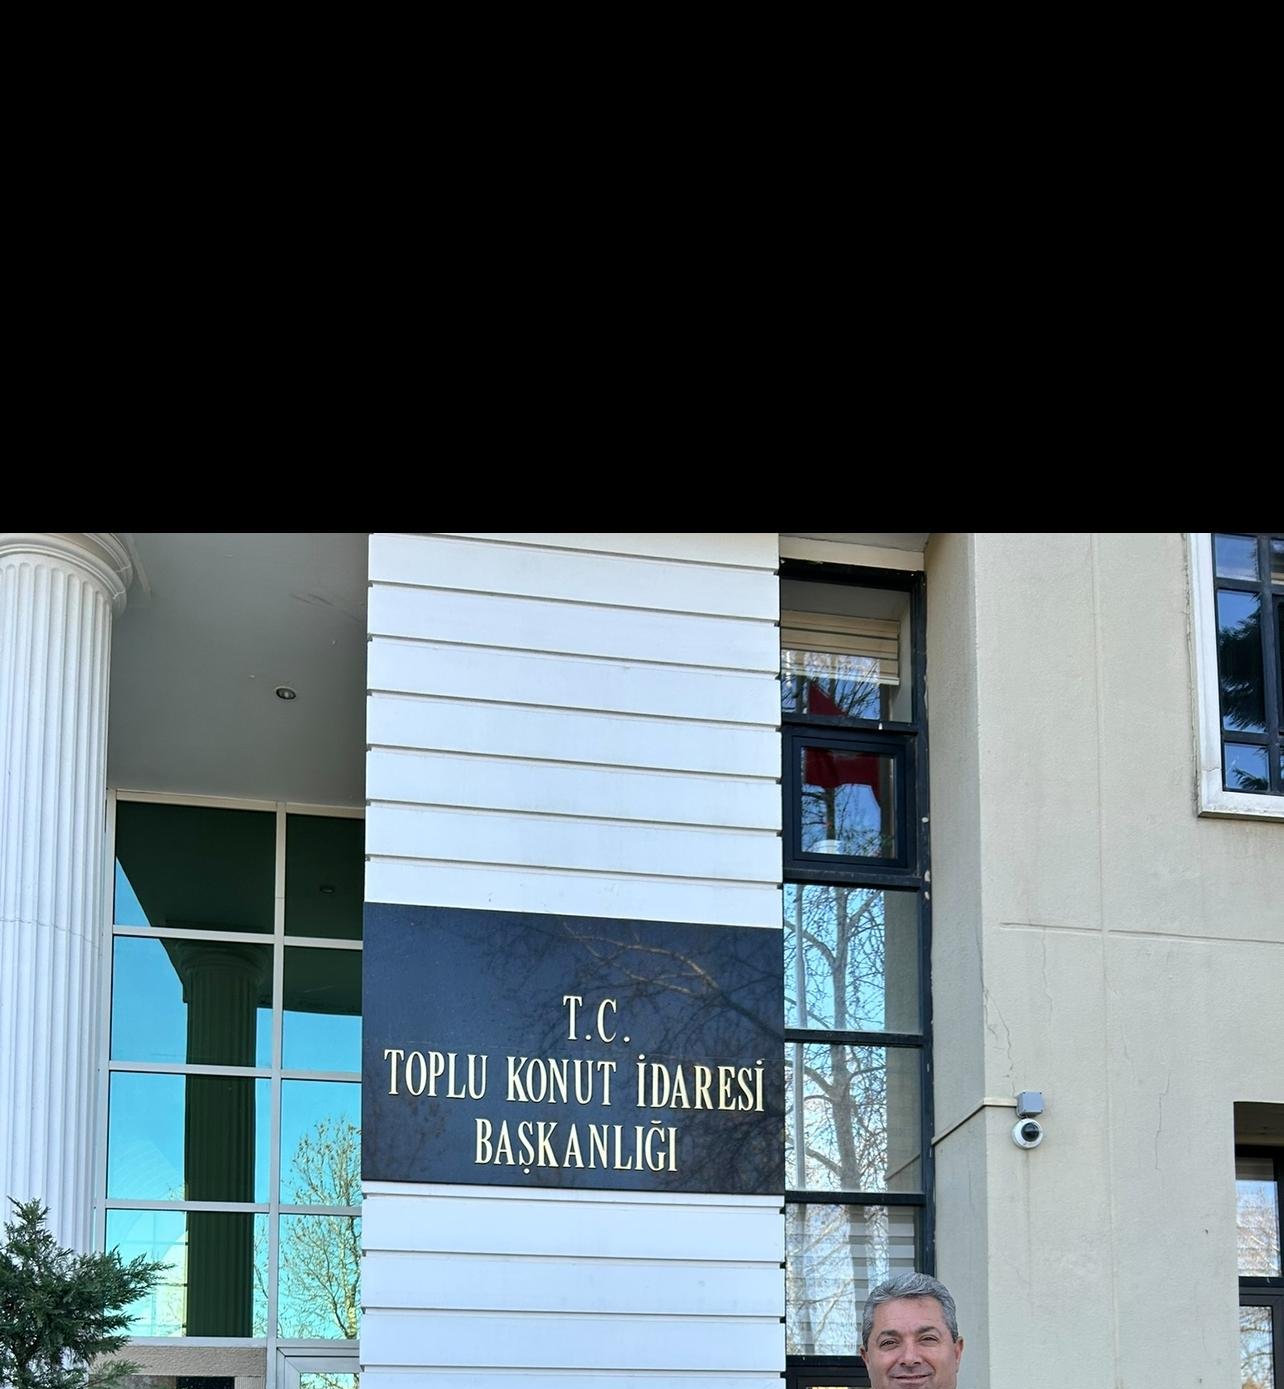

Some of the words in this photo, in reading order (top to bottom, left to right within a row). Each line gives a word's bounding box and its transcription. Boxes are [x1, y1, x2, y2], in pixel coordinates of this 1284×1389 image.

[563, 994, 631, 1044] T.C.
[384, 1048, 488, 1100] TOPLU
[506, 1056, 617, 1107] KONUT
[636, 1053, 766, 1113] İDARESİ
[475, 1117, 679, 1175] BAŞKANLIĞI
